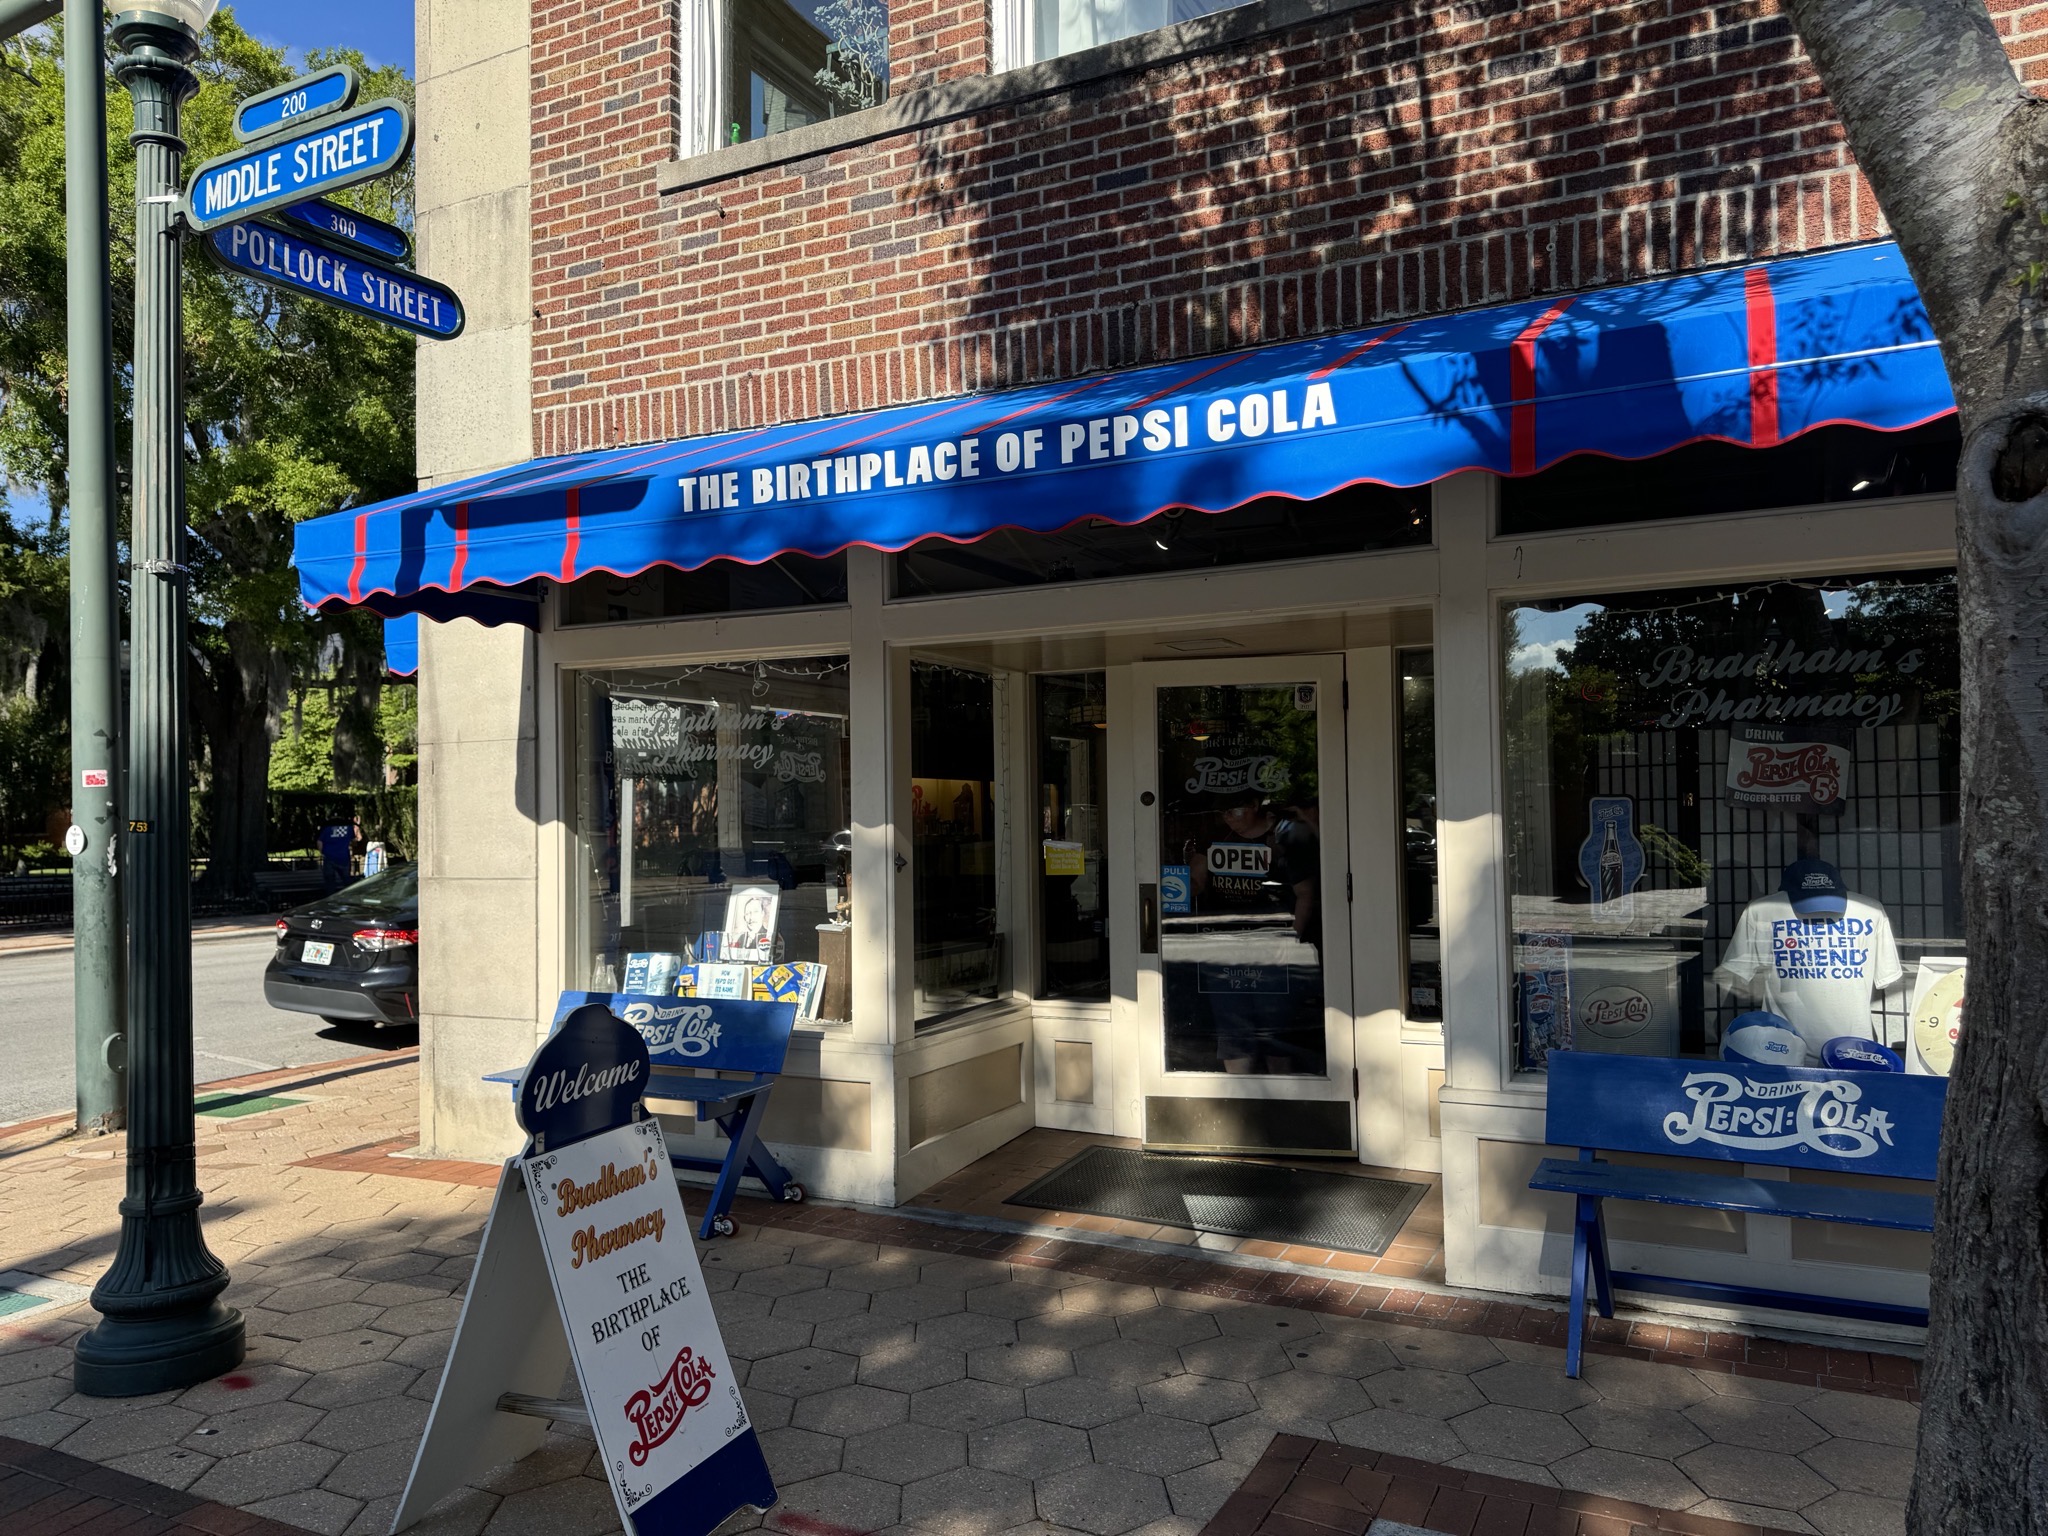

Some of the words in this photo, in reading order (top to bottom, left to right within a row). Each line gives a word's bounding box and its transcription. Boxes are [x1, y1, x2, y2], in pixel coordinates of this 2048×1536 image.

[281, 91, 307, 118] 200
[205, 153, 281, 215] MIDDLE
[293, 118, 384, 183] STREET
[330, 214, 357, 239] 300
[232, 225, 349, 296] POLLOCK
[362, 271, 441, 327] STREET
[678, 470, 739, 512] THE
[752, 436, 981, 506] BIRTHPLACE
[996, 427, 1044, 474] OF
[1061, 406, 1188, 464] PEPSI
[1207, 382, 1337, 443] COLA
[1639, 634, 1925, 688] Bradham's
[1659, 686, 1904, 729] Pharmacy
[644, 707, 784, 738] Bradham's
[1745, 728, 1784, 741] DRINK
[653, 743, 775, 769] Pharmacy
[129, 821, 149, 832] 753
[1163, 867, 1188, 875] PULL
[1211, 848, 1268, 871] OPEN
[1212, 876, 1262, 891] ARRAKIS
[1771, 918, 1873, 937] FRIENDS
[1773, 937, 1823, 949] DON'T
[1828, 937, 1856, 948] LET
[1773, 948, 1868, 967] FRIENDS
[1223, 967, 1263, 981] Sunday
[1229, 979, 1240, 989] 12
[1251, 979, 1257, 989] 4
[1776, 968, 1827, 979] DRINK
[1831, 967, 1864, 979] COK
[660, 1008, 684, 1019] DRINK
[1929, 1016, 1939, 1028] 9
[534, 1059, 640, 1112] Welcome
[1757, 1083, 1802, 1096] DRINK
[557, 1150, 657, 1217] Bradham's
[571, 1208, 666, 1269] Pharmacy
[616, 1263, 651, 1294] THE
[591, 1276, 692, 1345] BIRTHPLACE
[641, 1325, 662, 1351] OF
